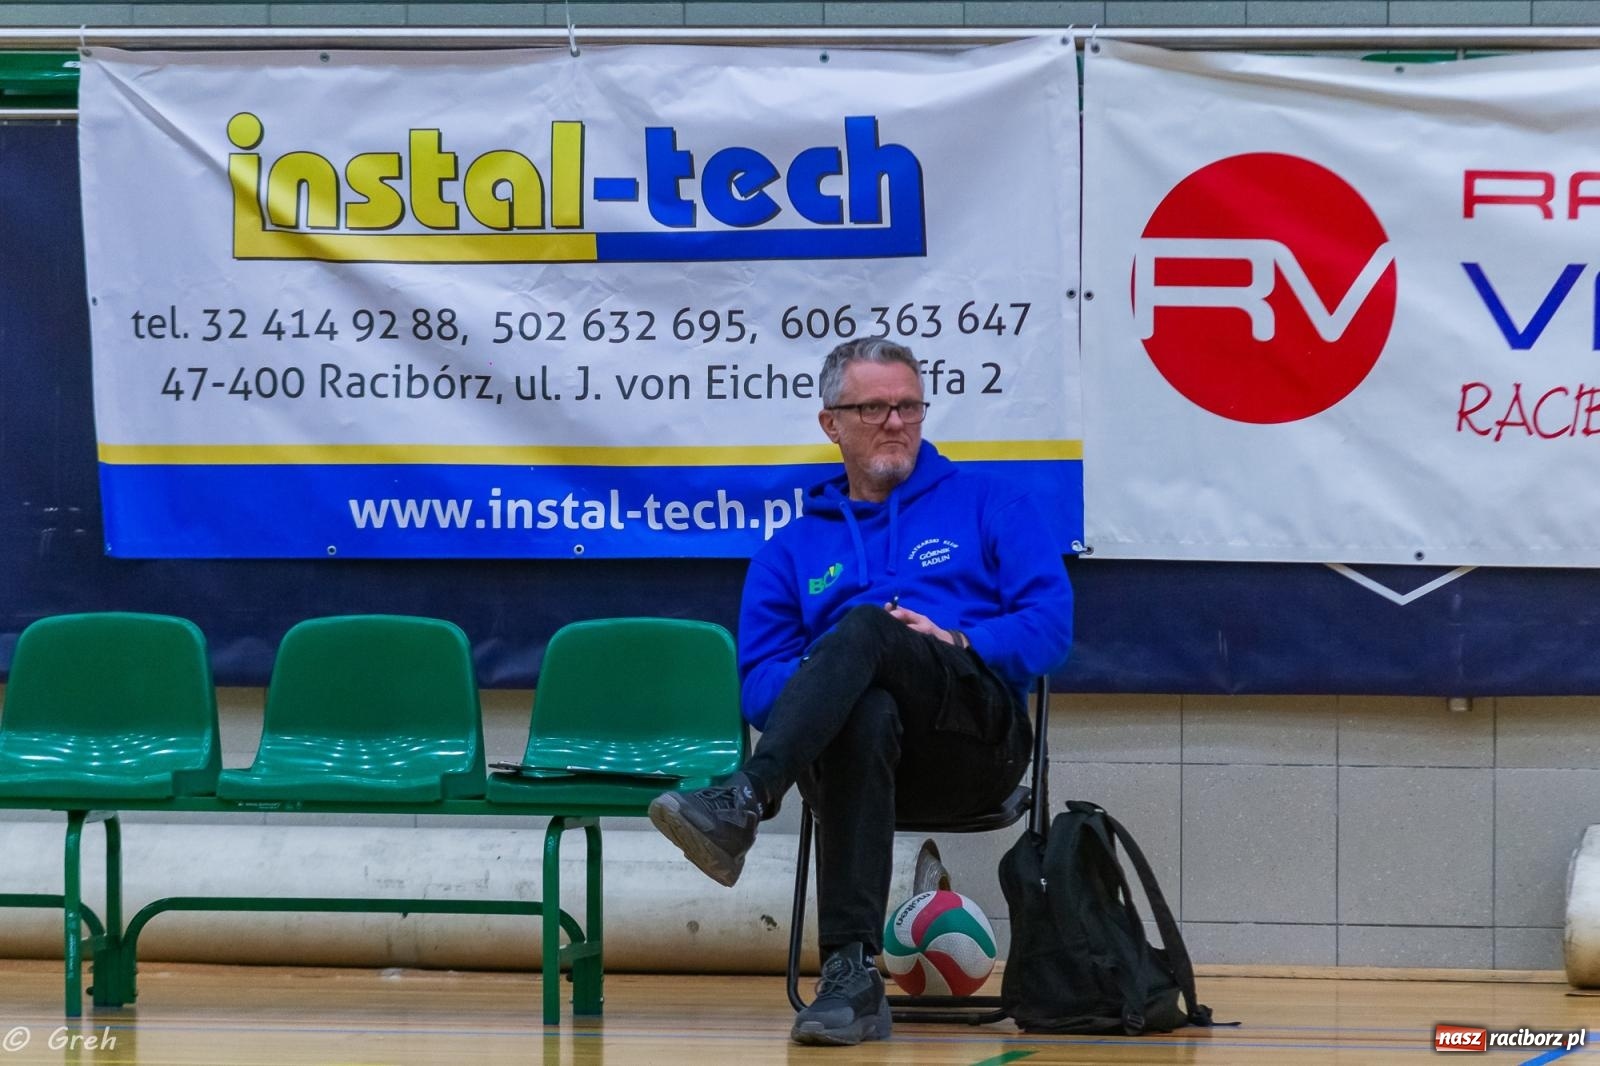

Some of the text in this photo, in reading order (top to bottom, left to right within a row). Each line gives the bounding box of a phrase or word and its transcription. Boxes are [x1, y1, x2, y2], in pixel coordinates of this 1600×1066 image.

[226, 111, 927, 262] instal-tech
[1134, 236, 1396, 343] RV
[1460, 261, 1600, 352] V
[130, 300, 1032, 346] tel. 32 414 92 88, 502 632 695, 606 363 647
[160, 359, 1003, 405] 47-400 Racibórz, ul. J. von Eichefa 2
[348, 487, 804, 542] www.instal-tech.pl
[921, 553, 951, 567] RADLIN
[895, 892, 931, 926] molten
